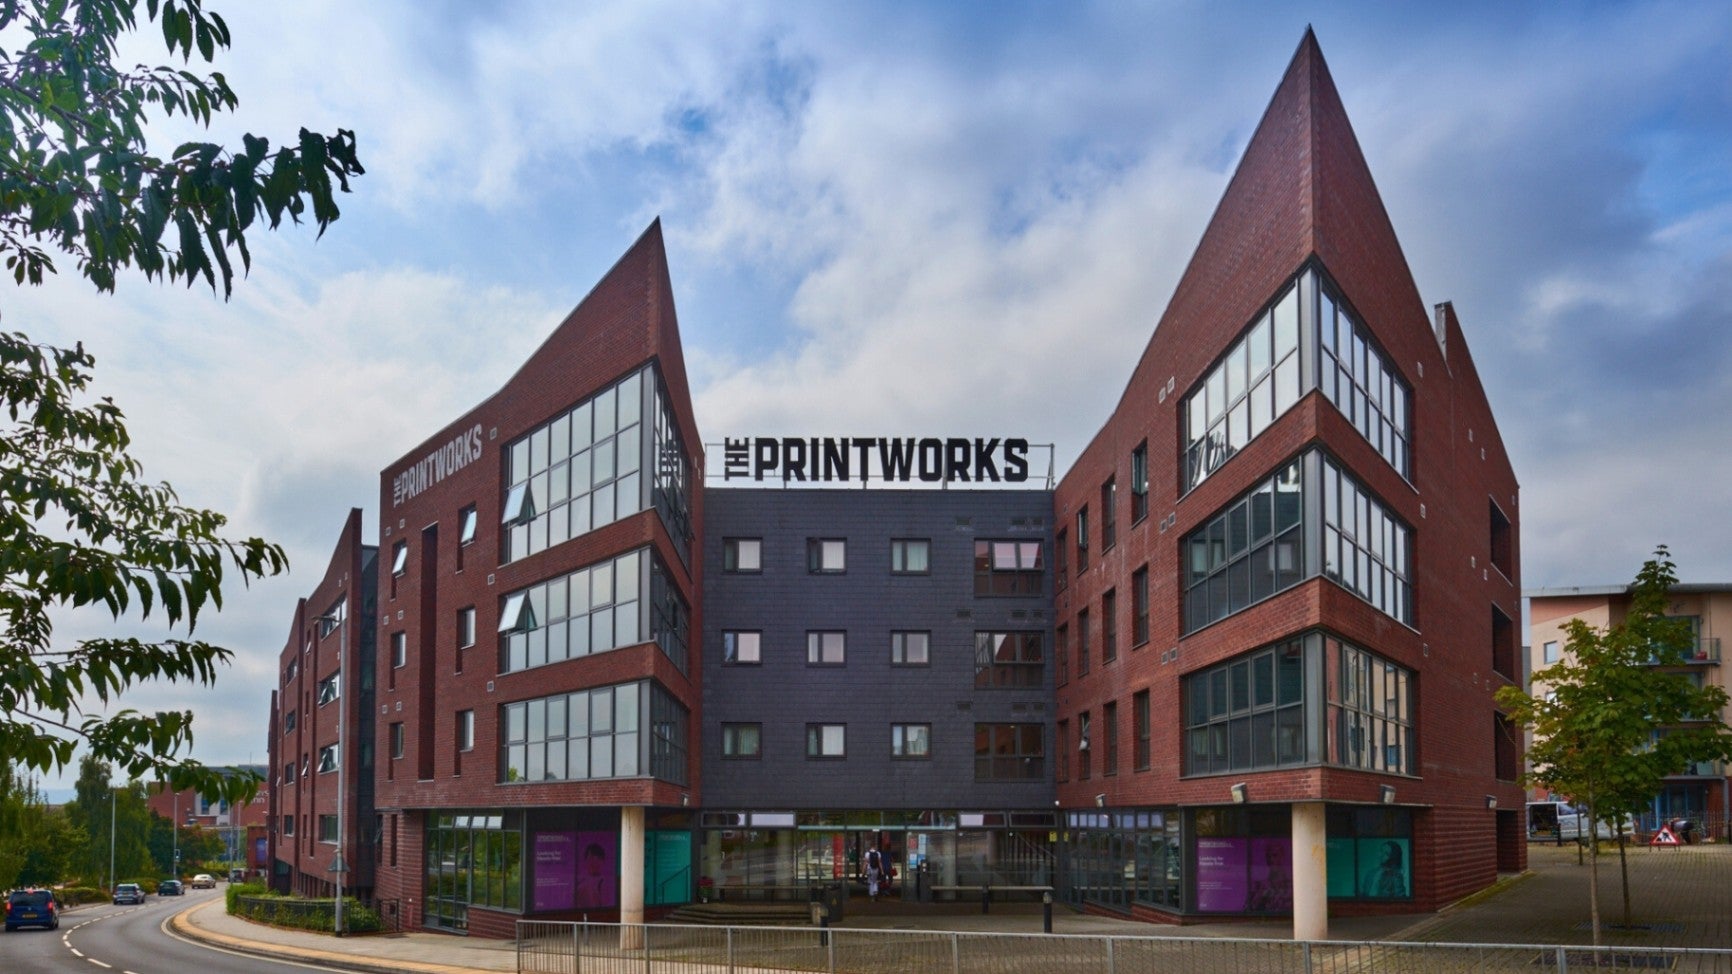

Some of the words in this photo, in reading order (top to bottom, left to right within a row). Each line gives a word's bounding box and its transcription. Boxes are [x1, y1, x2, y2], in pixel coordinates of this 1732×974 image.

[401, 423, 482, 504] PRINTWORKS
[725, 437, 749, 481] THE
[755, 437, 1028, 482] PRINTWORKS
